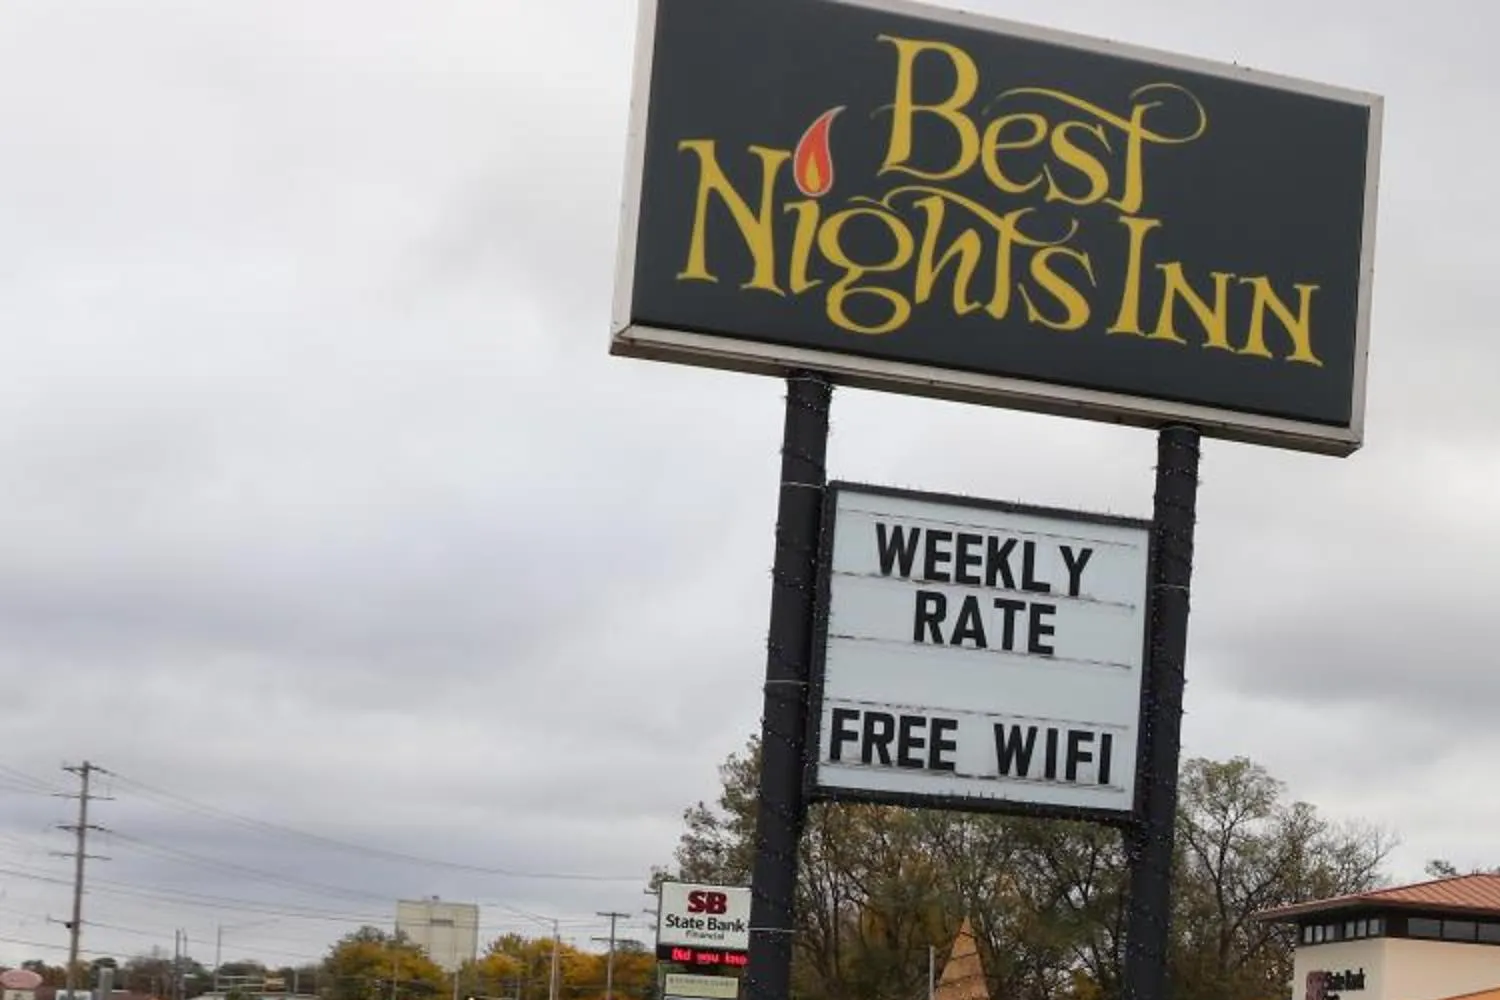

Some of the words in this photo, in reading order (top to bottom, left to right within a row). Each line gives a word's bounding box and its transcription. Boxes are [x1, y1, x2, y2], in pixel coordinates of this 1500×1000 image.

[870, 34, 1206, 214] Best
[677, 106, 1097, 335] Nights
[876, 522, 1093, 597] WEEKLY
[914, 590, 1056, 655] RATE
[830, 707, 958, 771] FREE
[994, 723, 1112, 785] WIFI
[665, 914, 704, 929] State
[707, 917, 745, 932] Bank
[687, 890, 727, 914] SB
